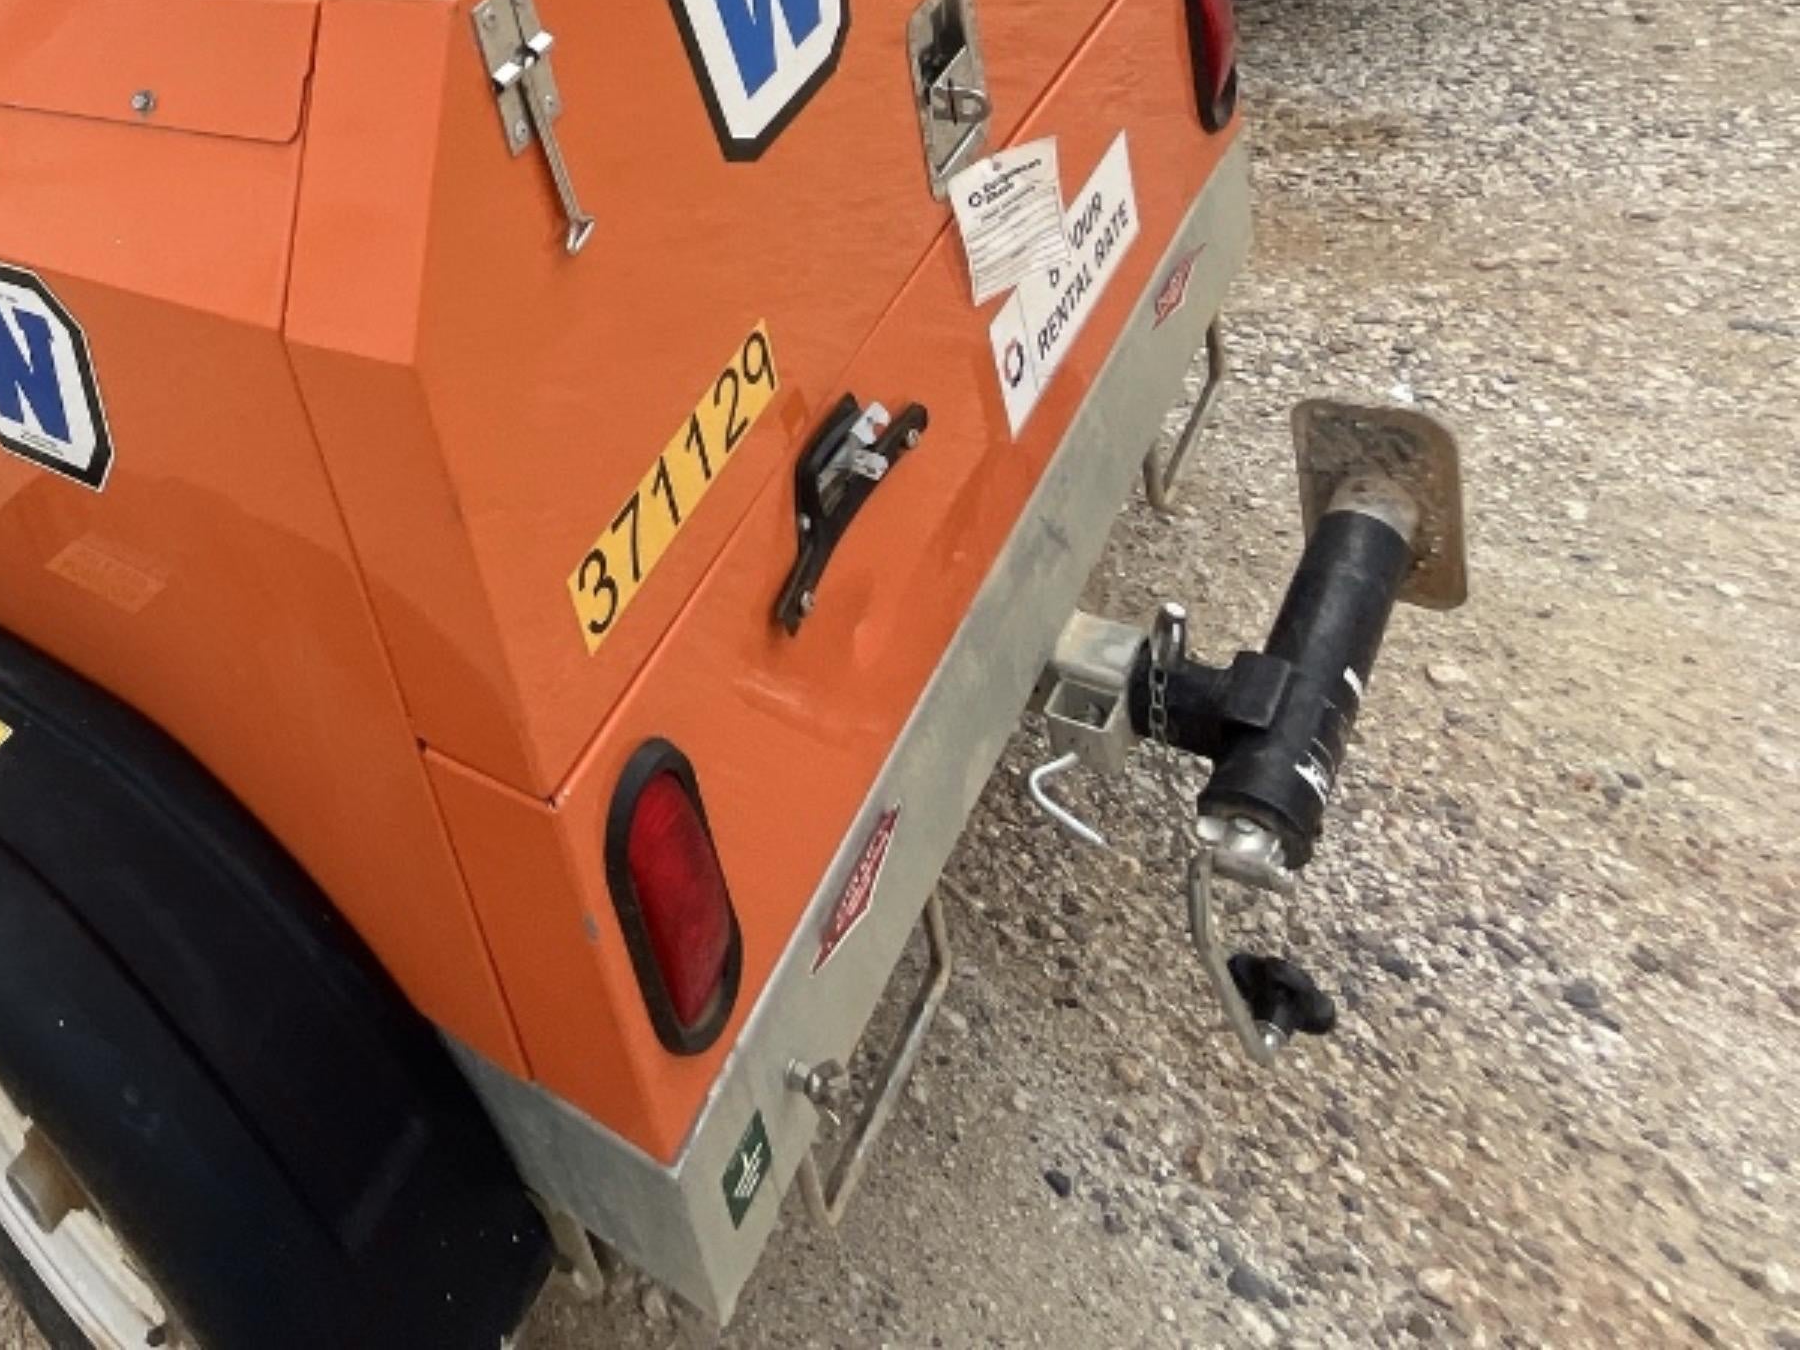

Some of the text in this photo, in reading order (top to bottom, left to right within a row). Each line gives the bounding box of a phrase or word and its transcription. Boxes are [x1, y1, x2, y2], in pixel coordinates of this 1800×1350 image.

[1036, 199, 1129, 360] RENTAL RATE
[577, 329, 776, 635] 371129
